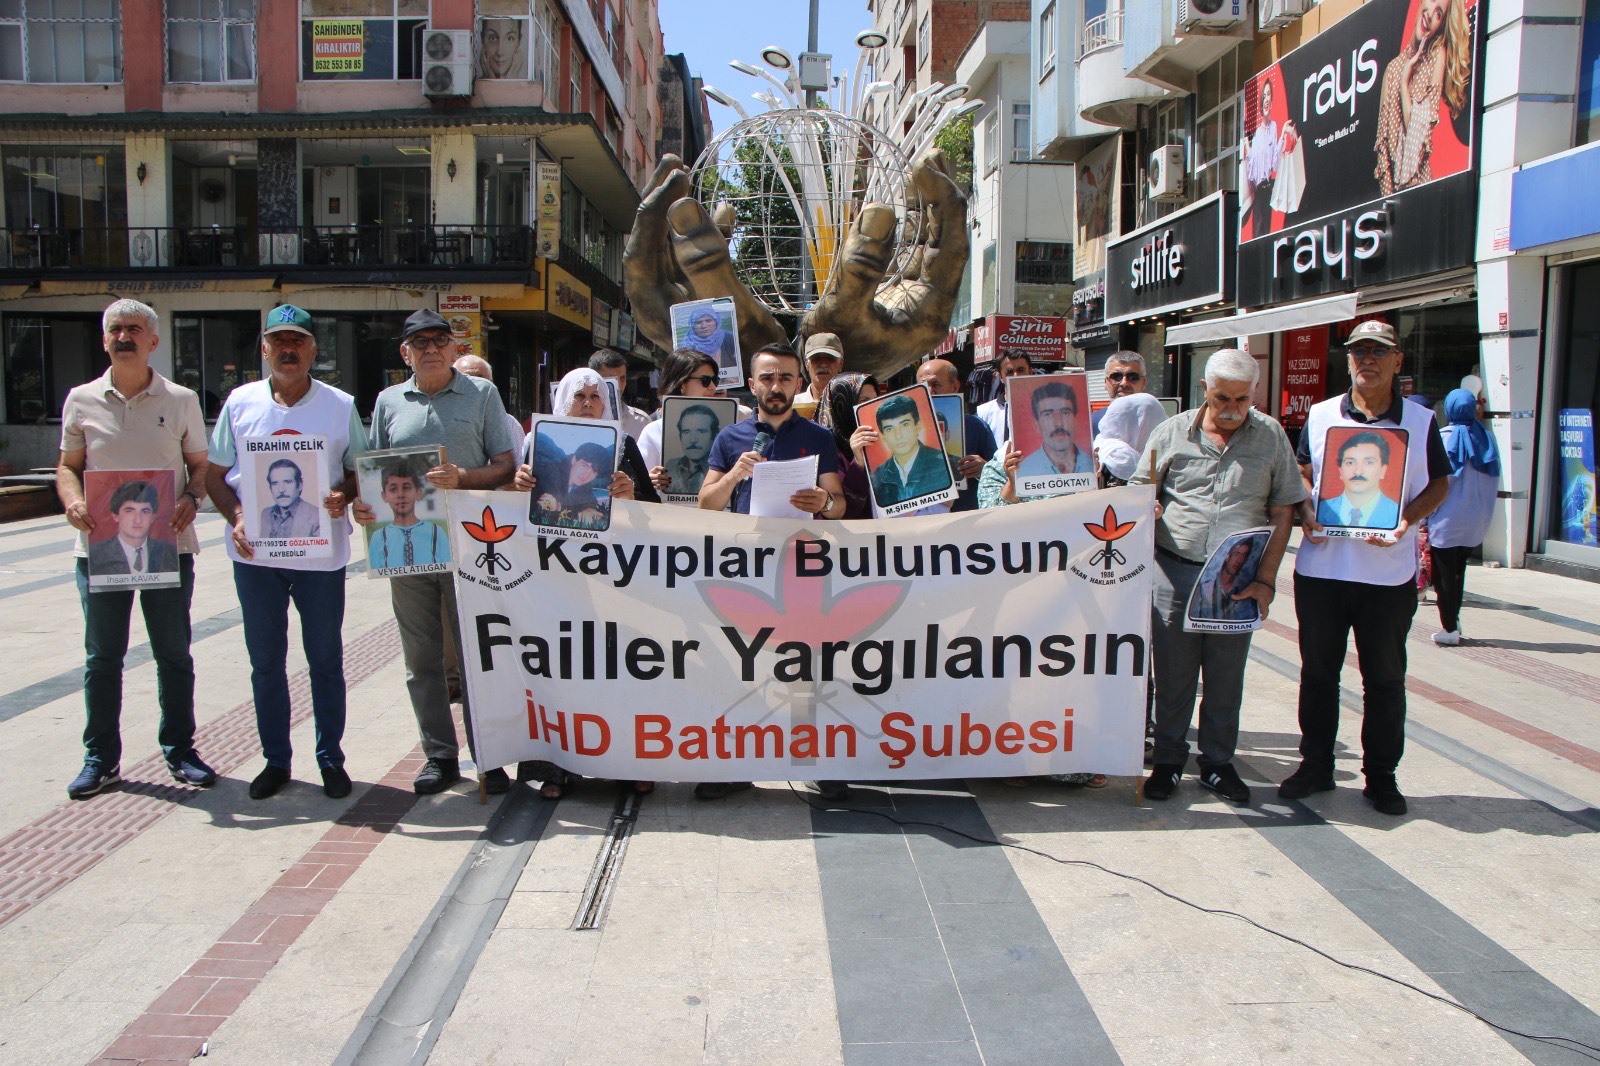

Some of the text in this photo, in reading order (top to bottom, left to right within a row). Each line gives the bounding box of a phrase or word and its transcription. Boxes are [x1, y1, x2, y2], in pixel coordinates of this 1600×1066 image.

[315, 22, 362, 36] SAHİBİNDEN
[315, 60, 330, 70] 0532
[331, 60, 343, 70] 553
[1302, 39, 1378, 123] rays
[1273, 211, 1383, 280] rays
[1131, 229, 1182, 289] stilife
[148, 280, 205, 291] SOFRASI
[440, 302, 479, 310] SOFRASI
[1009, 319, 1053, 335] Şirin
[999, 333, 1061, 345] Collection
[1288, 358, 1320, 370] YAZ SEZONU
[1287, 374, 1319, 384] FIRSATLARI
[246, 438, 325, 453] İBRAHİM ÇELİK
[1024, 476, 1090, 491] Eset GÖKTAYI
[919, 491, 949, 506] MALTU
[537, 526, 568, 537] İSMAİL
[289, 538, 329, 548] GÖZALTINDA
[269, 549, 307, 558] KAYBEDİLDİ
[537, 534, 1068, 588] Kayıplar Bulunsun
[377, 563, 447, 576] VEYSEL ATILGAN
[1070, 565, 1088, 580] İNSAN
[1089, 577, 1116, 586] HAKLARI
[131, 574, 161, 583] KAVAK
[1191, 622, 1220, 630] Mehmet
[475, 613, 1145, 696] Failler Yargılansın
[525, 689, 1074, 769] İHD Batman Şubesi
